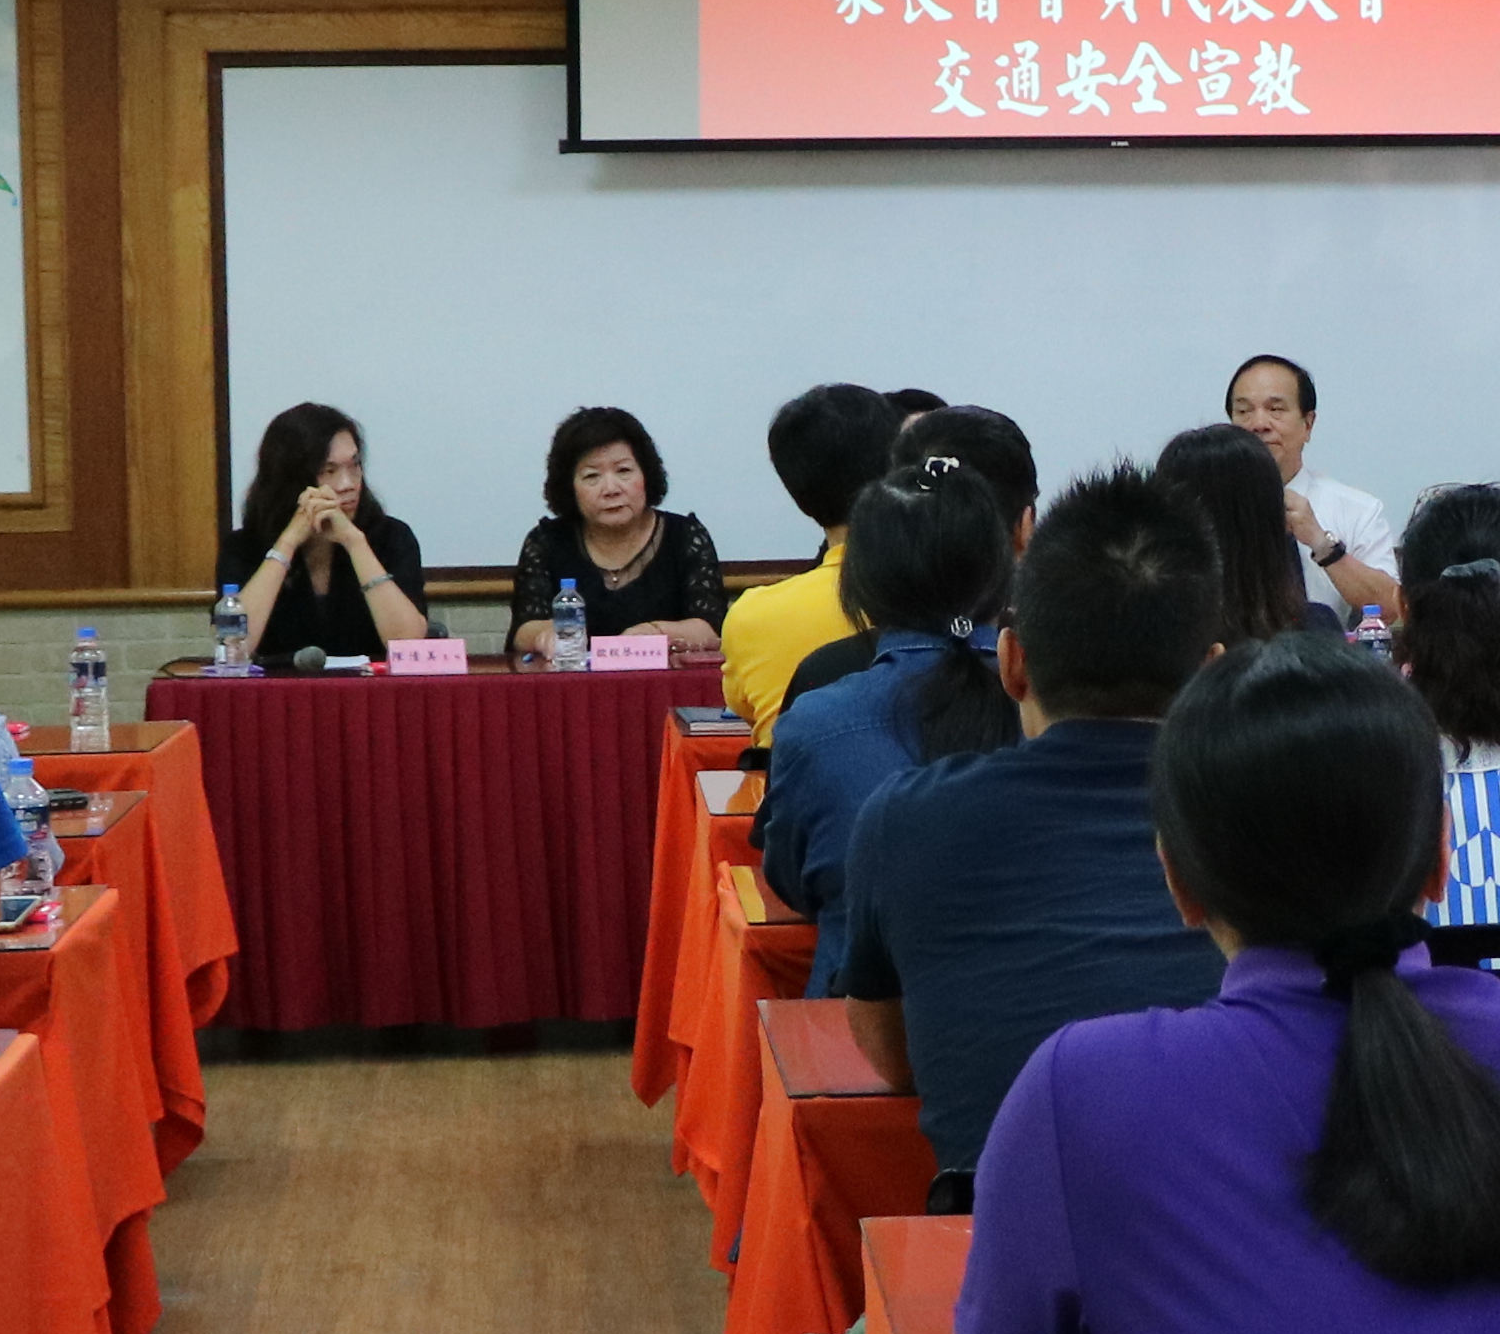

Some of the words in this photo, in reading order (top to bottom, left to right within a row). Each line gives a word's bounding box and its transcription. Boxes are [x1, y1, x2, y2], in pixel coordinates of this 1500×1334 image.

[931, 38, 1312, 118] 交通安全宣教
